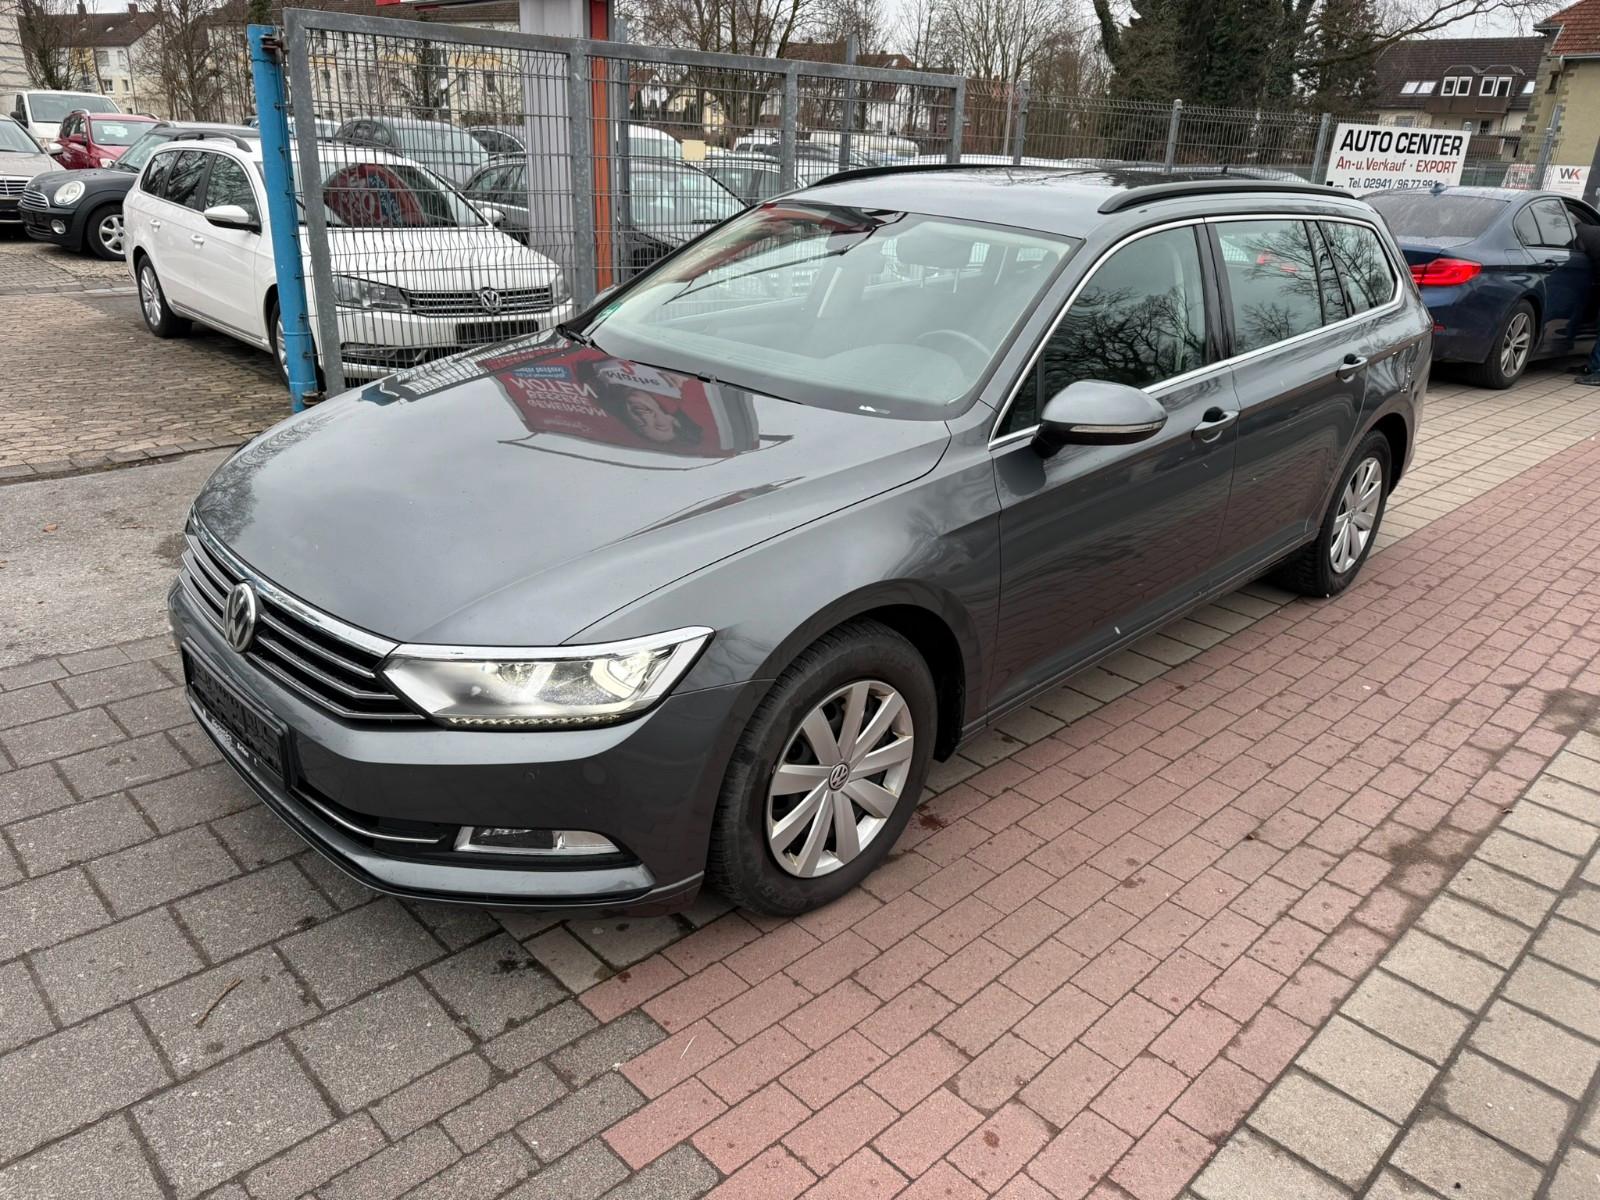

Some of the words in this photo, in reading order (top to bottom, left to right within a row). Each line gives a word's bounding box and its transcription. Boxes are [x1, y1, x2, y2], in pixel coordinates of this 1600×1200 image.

[1340, 129, 1393, 153] AUTO
[1395, 132, 1464, 156] CENTER
[1415, 159, 1457, 174] EXPORT
[1560, 167, 1581, 180] WK
[1348, 177, 1362, 188] Tel.
